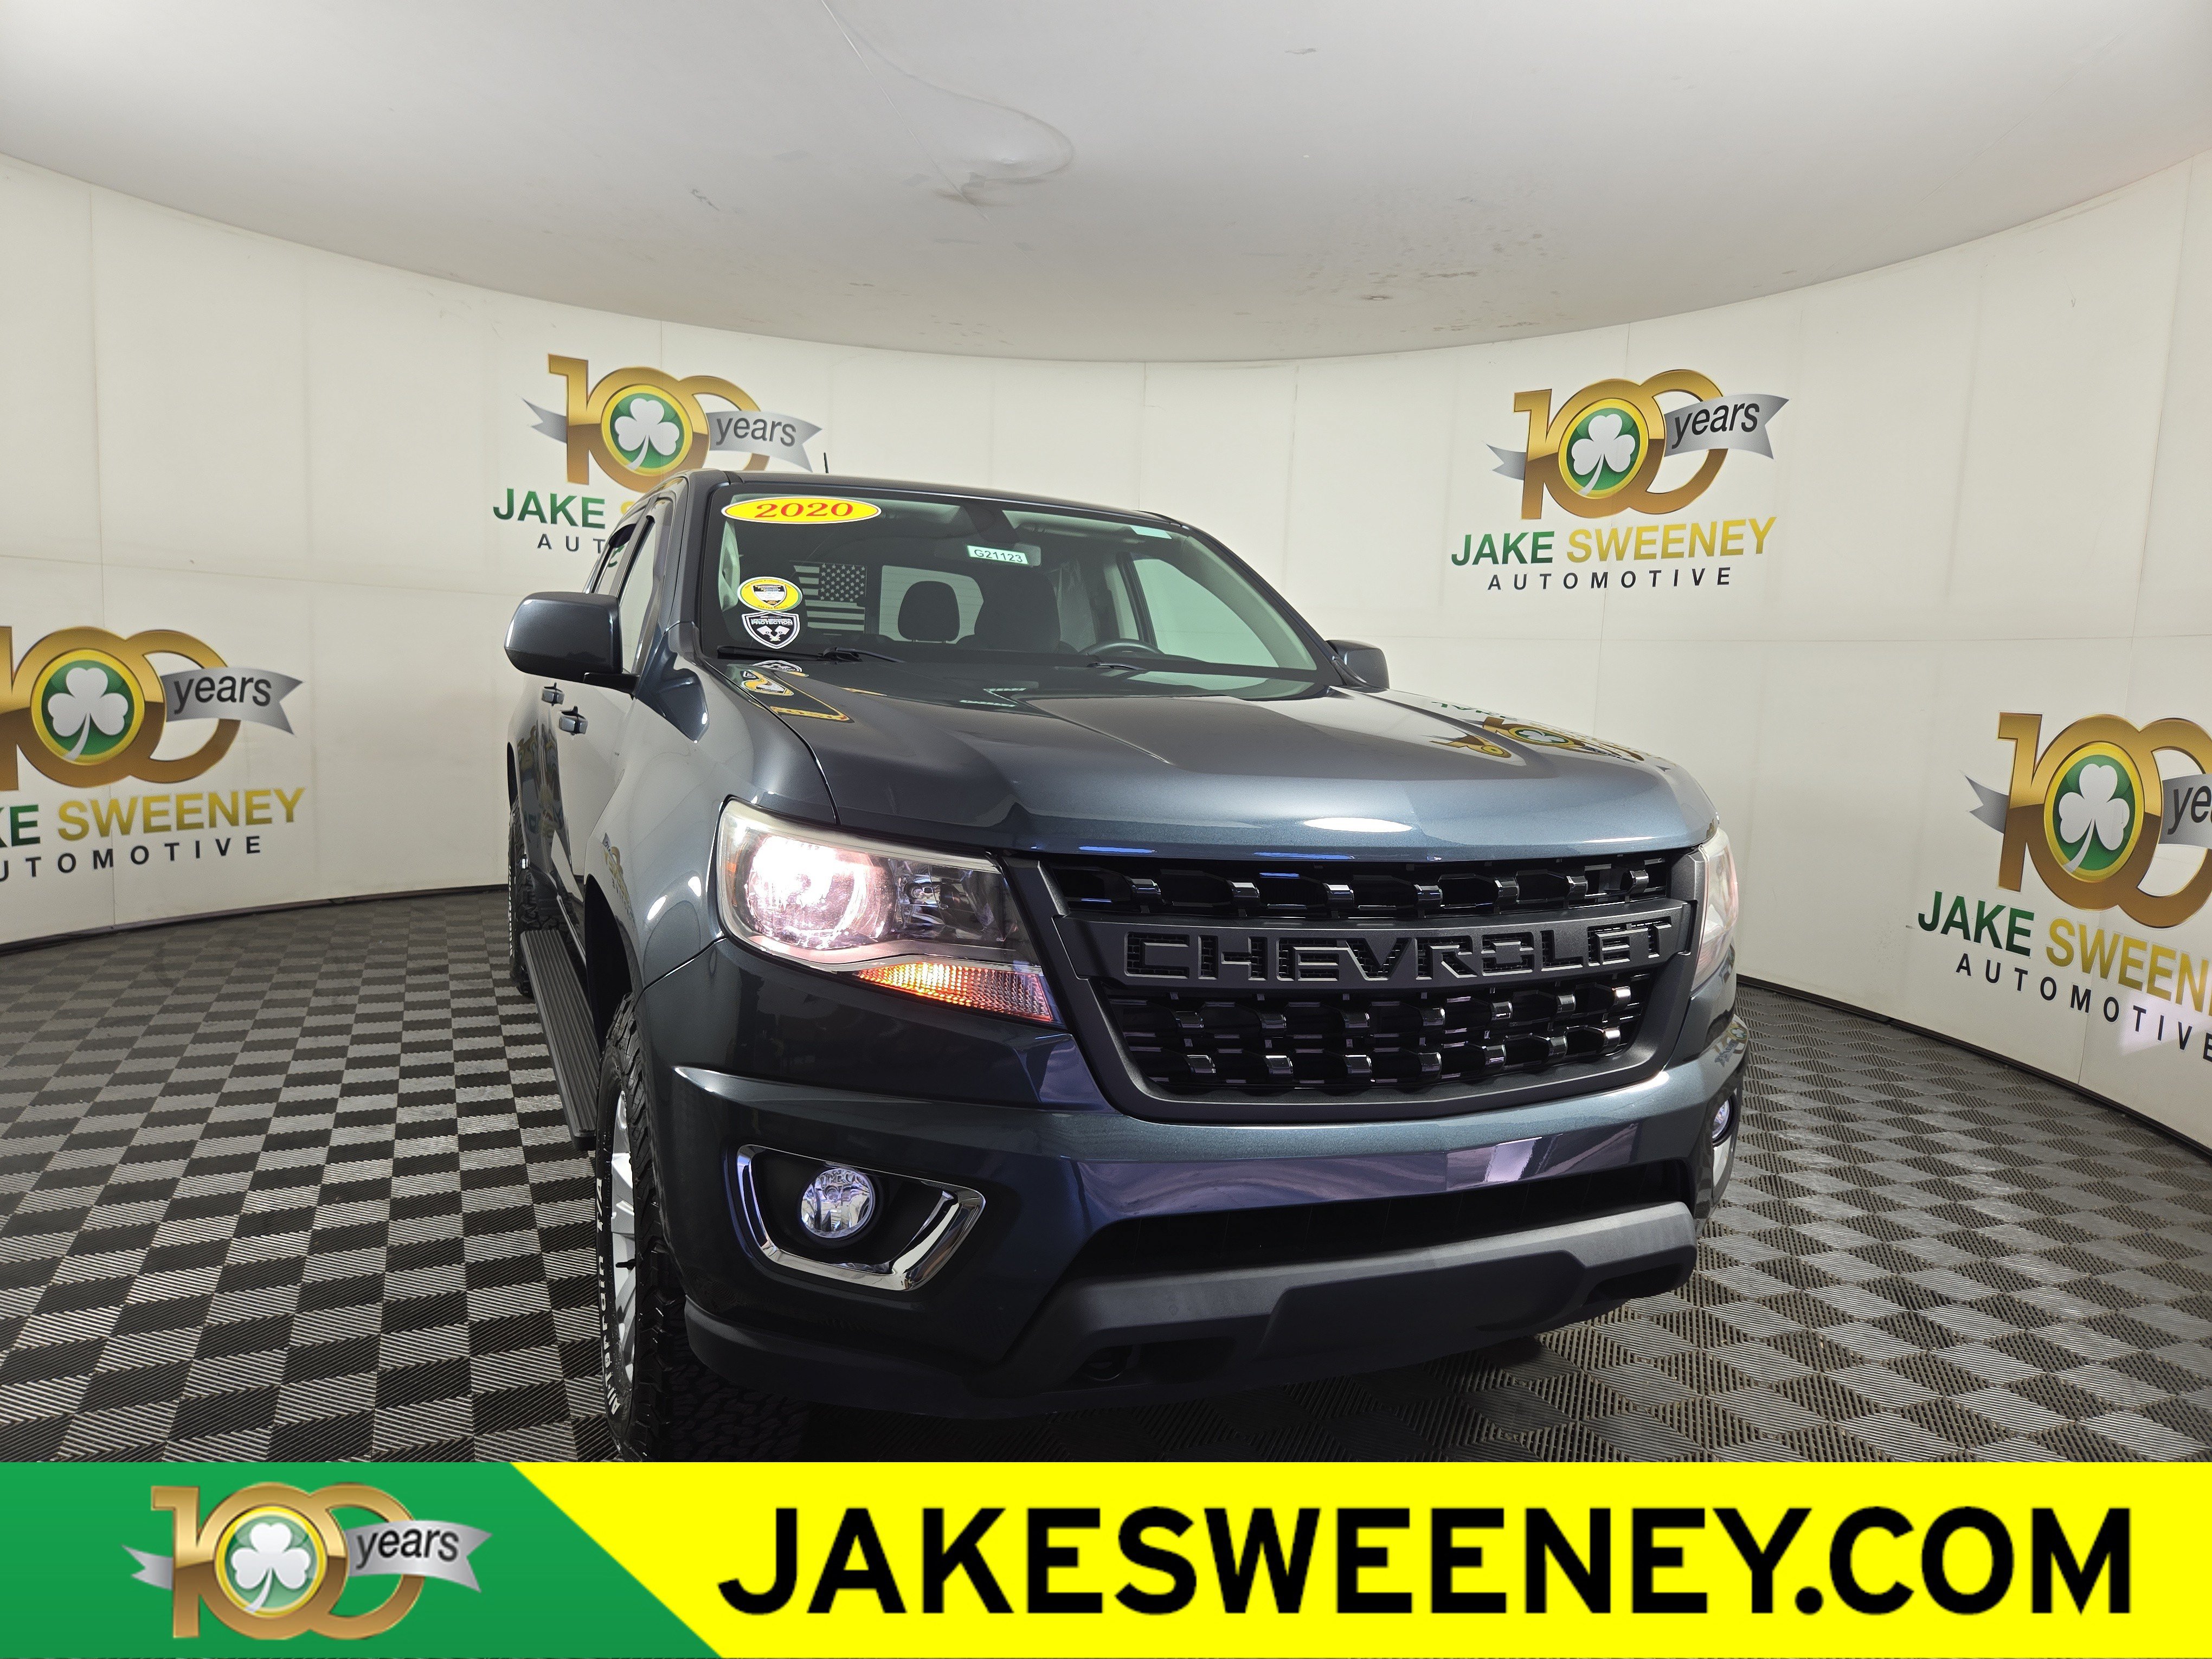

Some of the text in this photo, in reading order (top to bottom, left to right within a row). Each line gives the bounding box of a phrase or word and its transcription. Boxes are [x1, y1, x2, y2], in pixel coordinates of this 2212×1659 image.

[716, 417, 796, 447] years
[1513, 369, 1760, 519] 100 years
[493, 487, 606, 529] JAKE
[754, 502, 853, 518] 2020
[974, 549, 1023, 562] G21123
[1451, 516, 1777, 567] JAKE SWEENEY
[1487, 567, 1731, 591] AUTOMOTIVE
[173, 676, 271, 714] years
[57, 787, 305, 842] SWEENEY
[0, 835, 260, 882] UTOMOTIVE
[1124, 916, 1672, 981] CHEVROLET
[1918, 890, 2212, 1017] JAKE SWEEN
